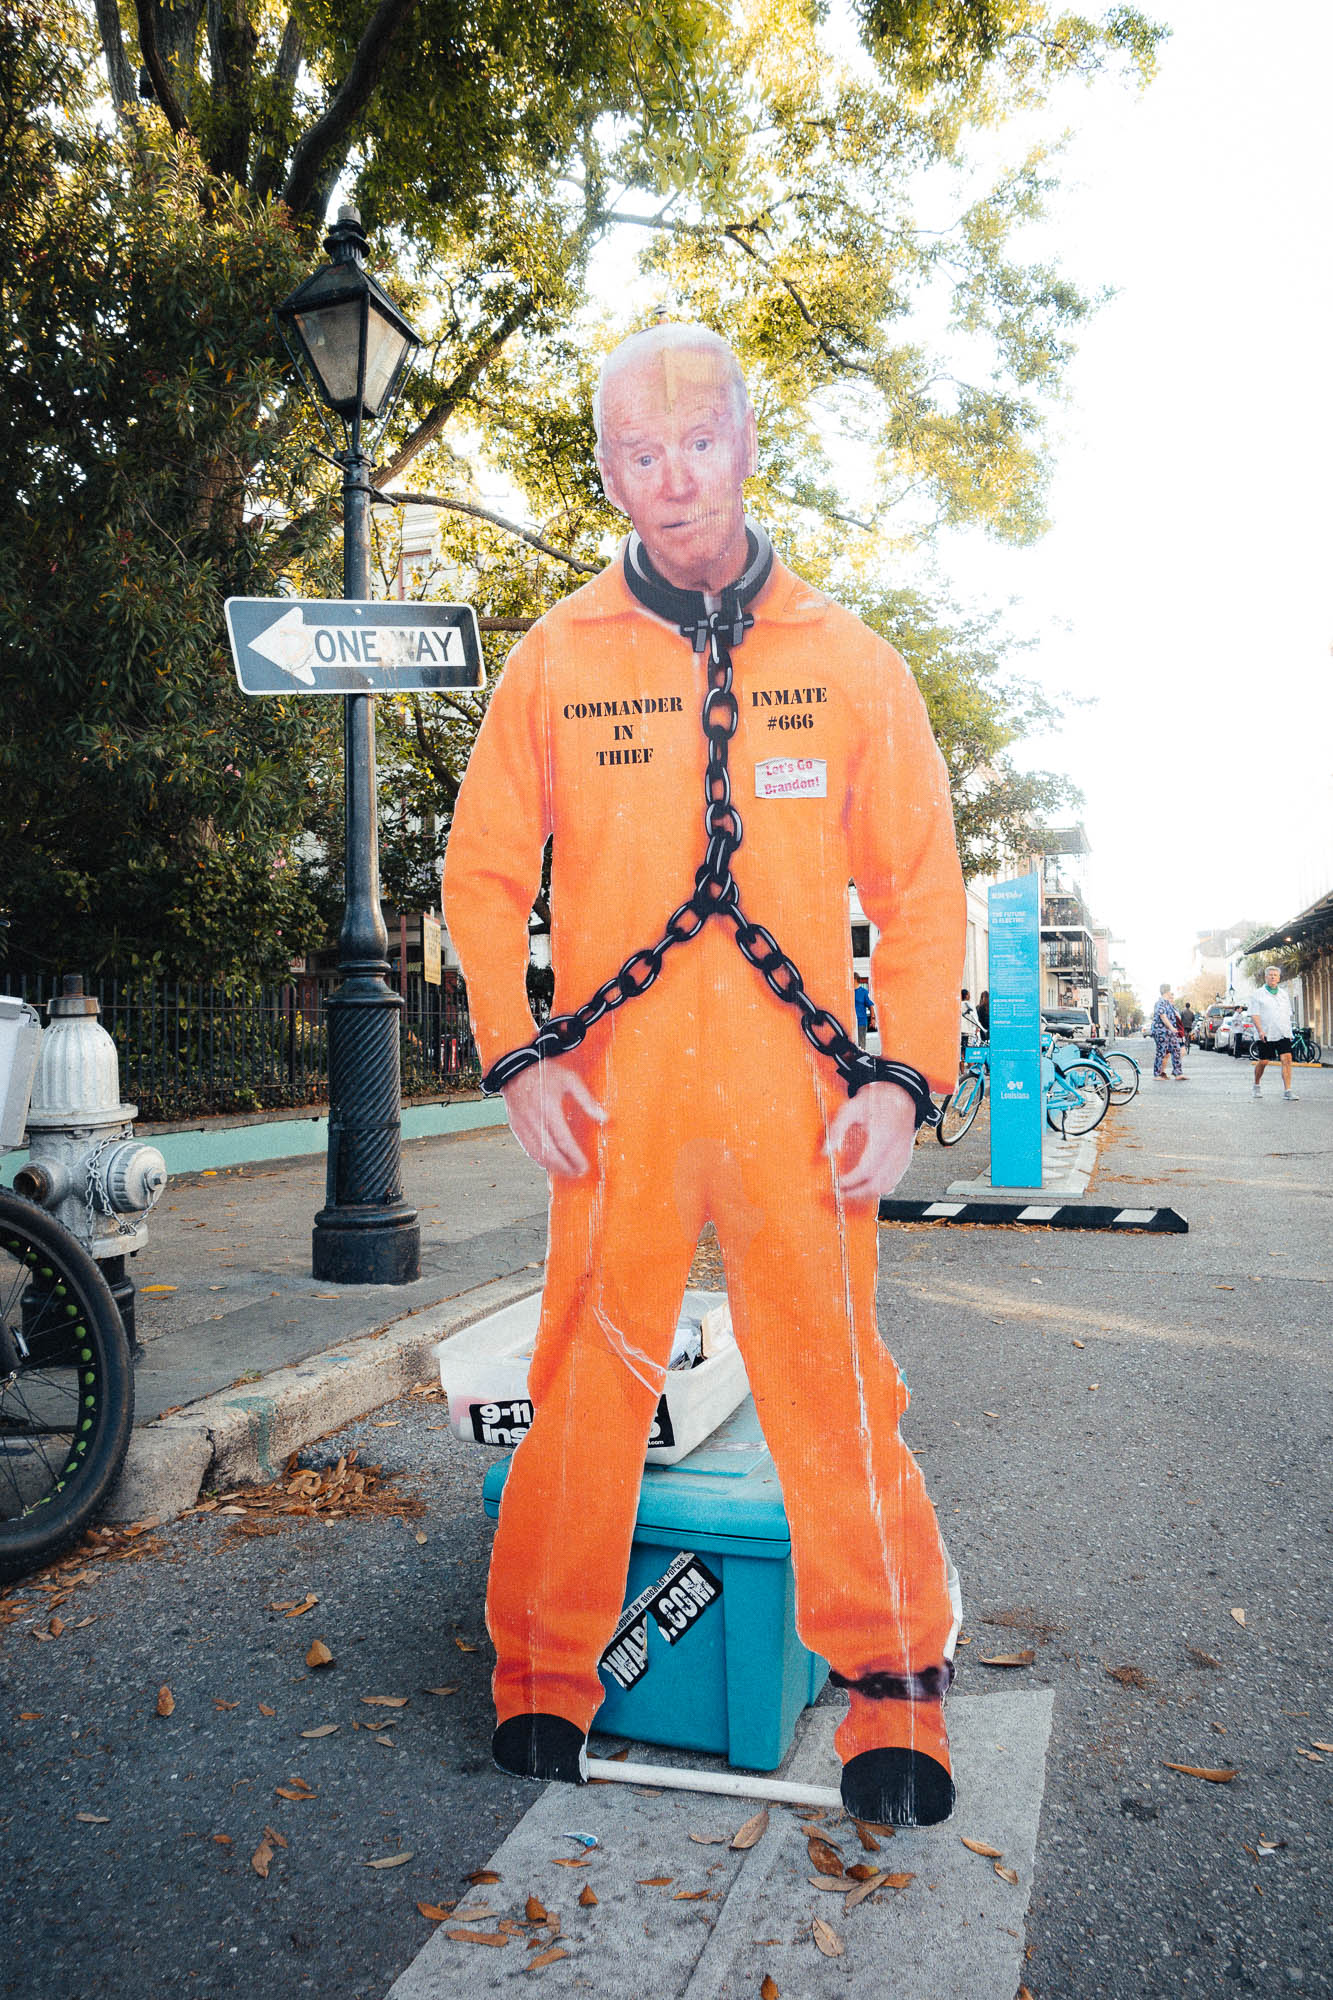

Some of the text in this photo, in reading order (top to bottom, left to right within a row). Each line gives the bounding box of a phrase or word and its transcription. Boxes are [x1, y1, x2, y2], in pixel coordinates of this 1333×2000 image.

[314, 629, 381, 663] ONE
[752, 687, 828, 707] INMATE
[563, 697, 684, 719] COMMANDER
[767, 713, 814, 731] #666
[613, 725, 634, 740] IN
[595, 748, 654, 766] THIEF
[765, 759, 813, 776] Let's Go
[764, 776, 820, 795] Brandon!
[479, 1402, 532, 1425] 9-11
[481, 1423, 531, 1444] Ins
